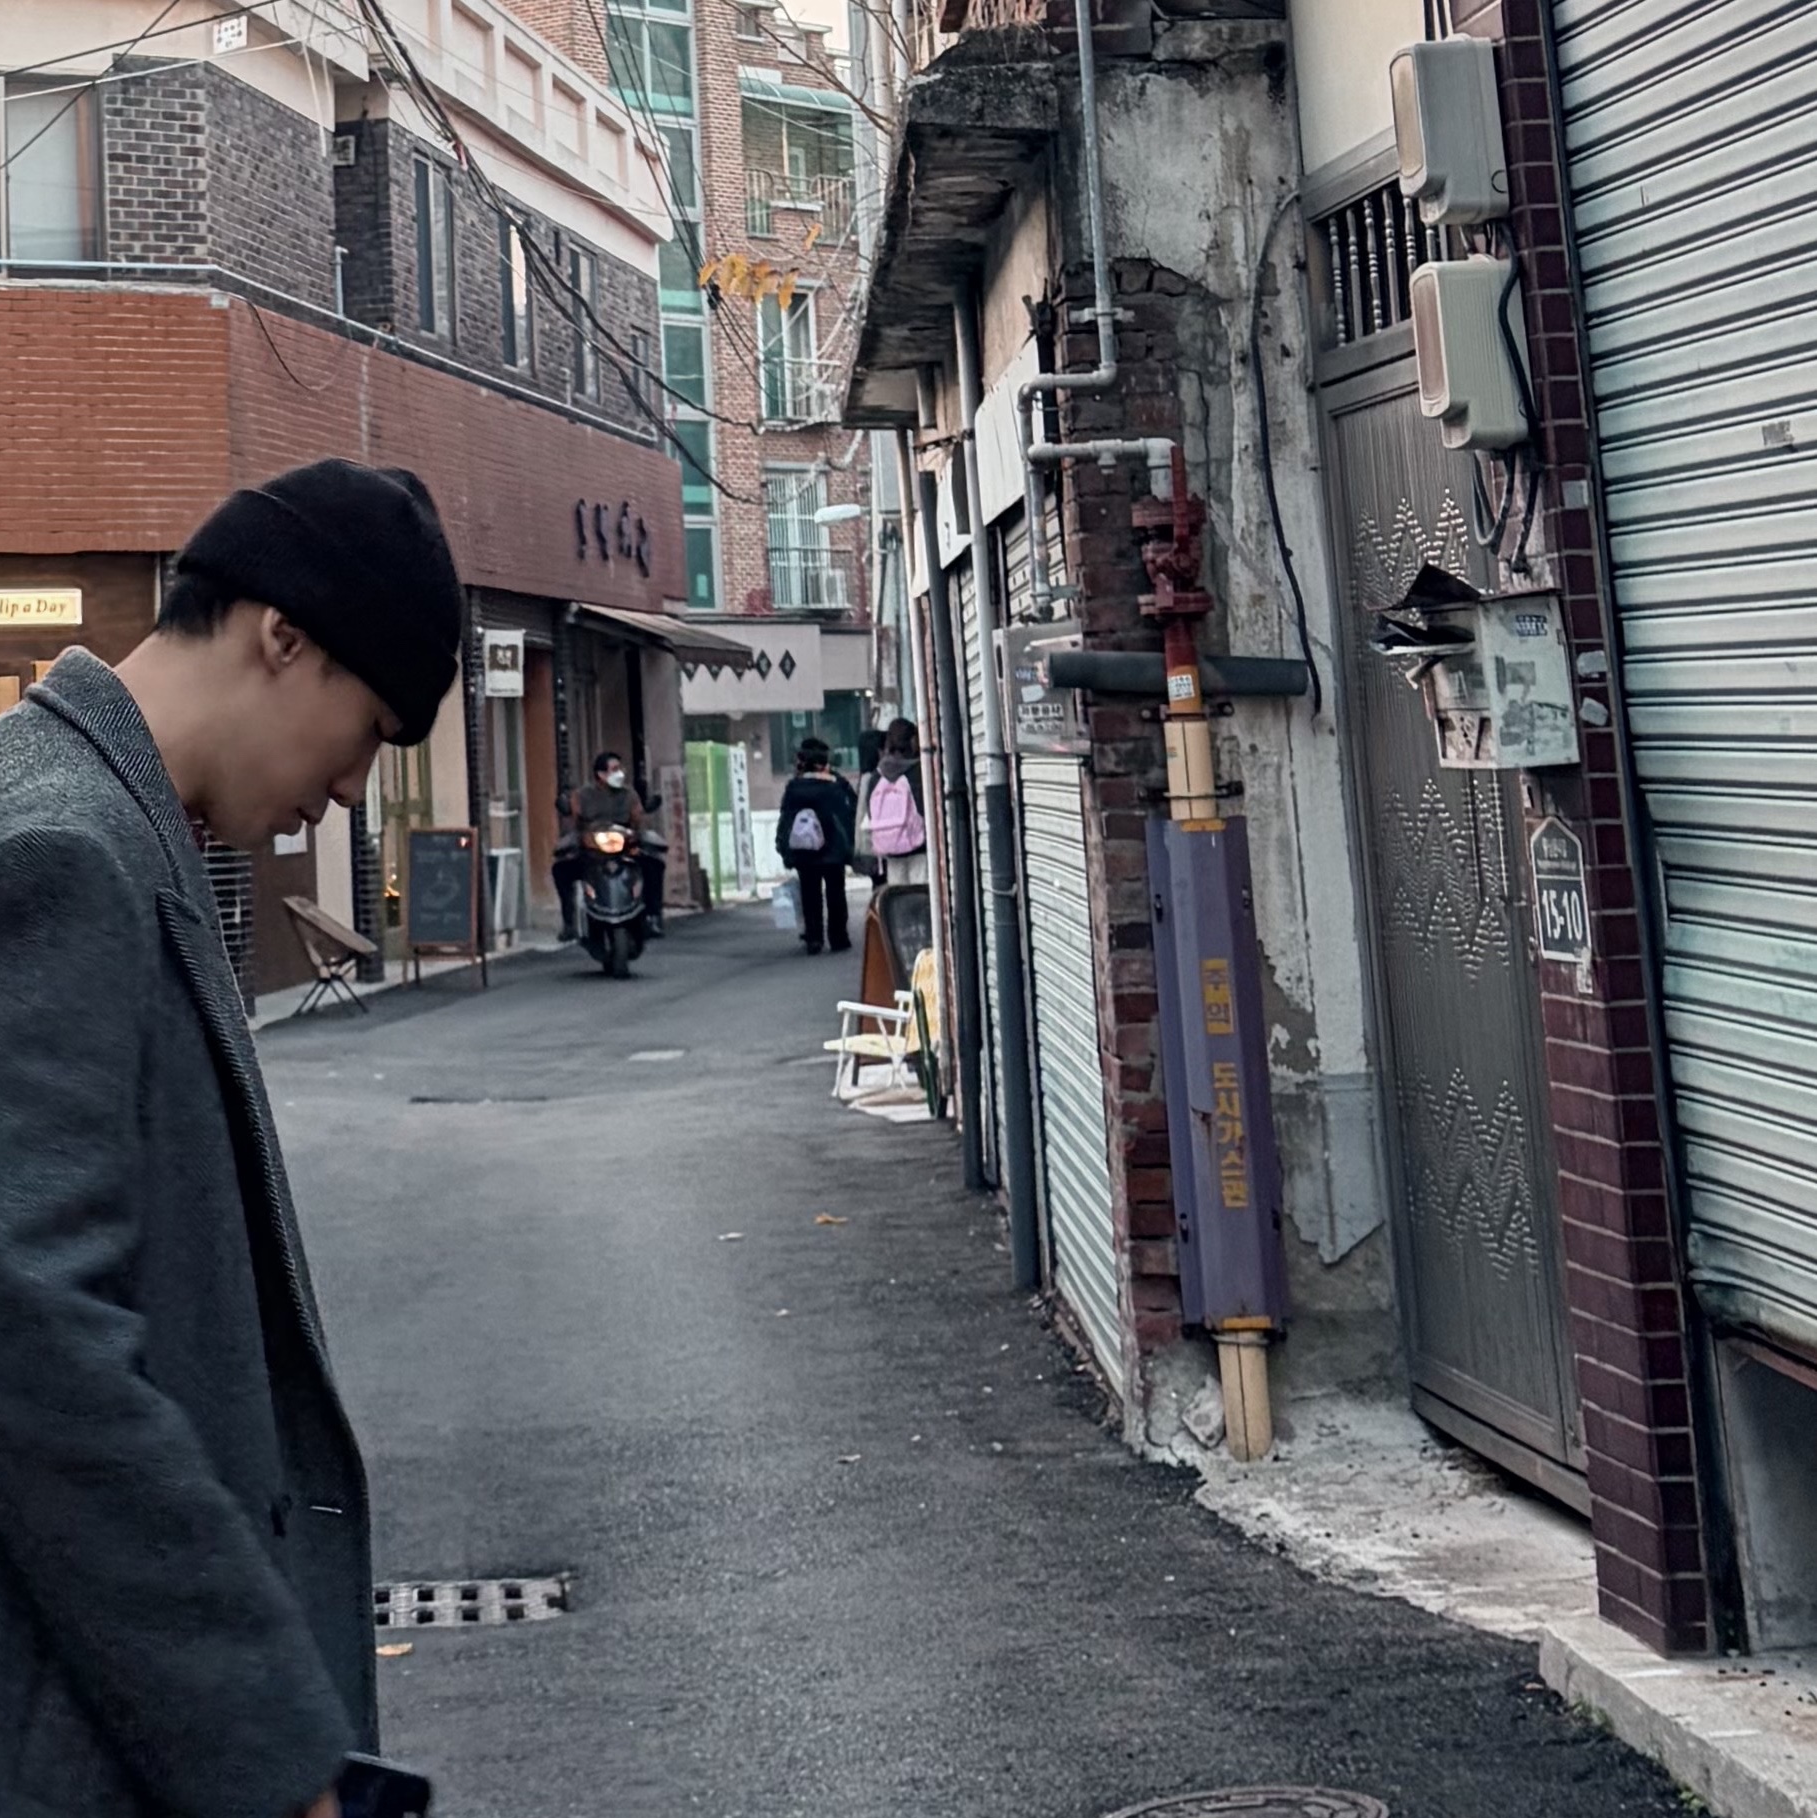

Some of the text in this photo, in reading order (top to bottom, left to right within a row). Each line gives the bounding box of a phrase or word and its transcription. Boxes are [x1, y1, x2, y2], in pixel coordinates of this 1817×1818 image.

[23, 604, 31, 613] a
[36, 599, 67, 617] Day
[1541, 889, 1584, 941] 15-10
[1213, 1062, 1249, 1208] 도시가스관
